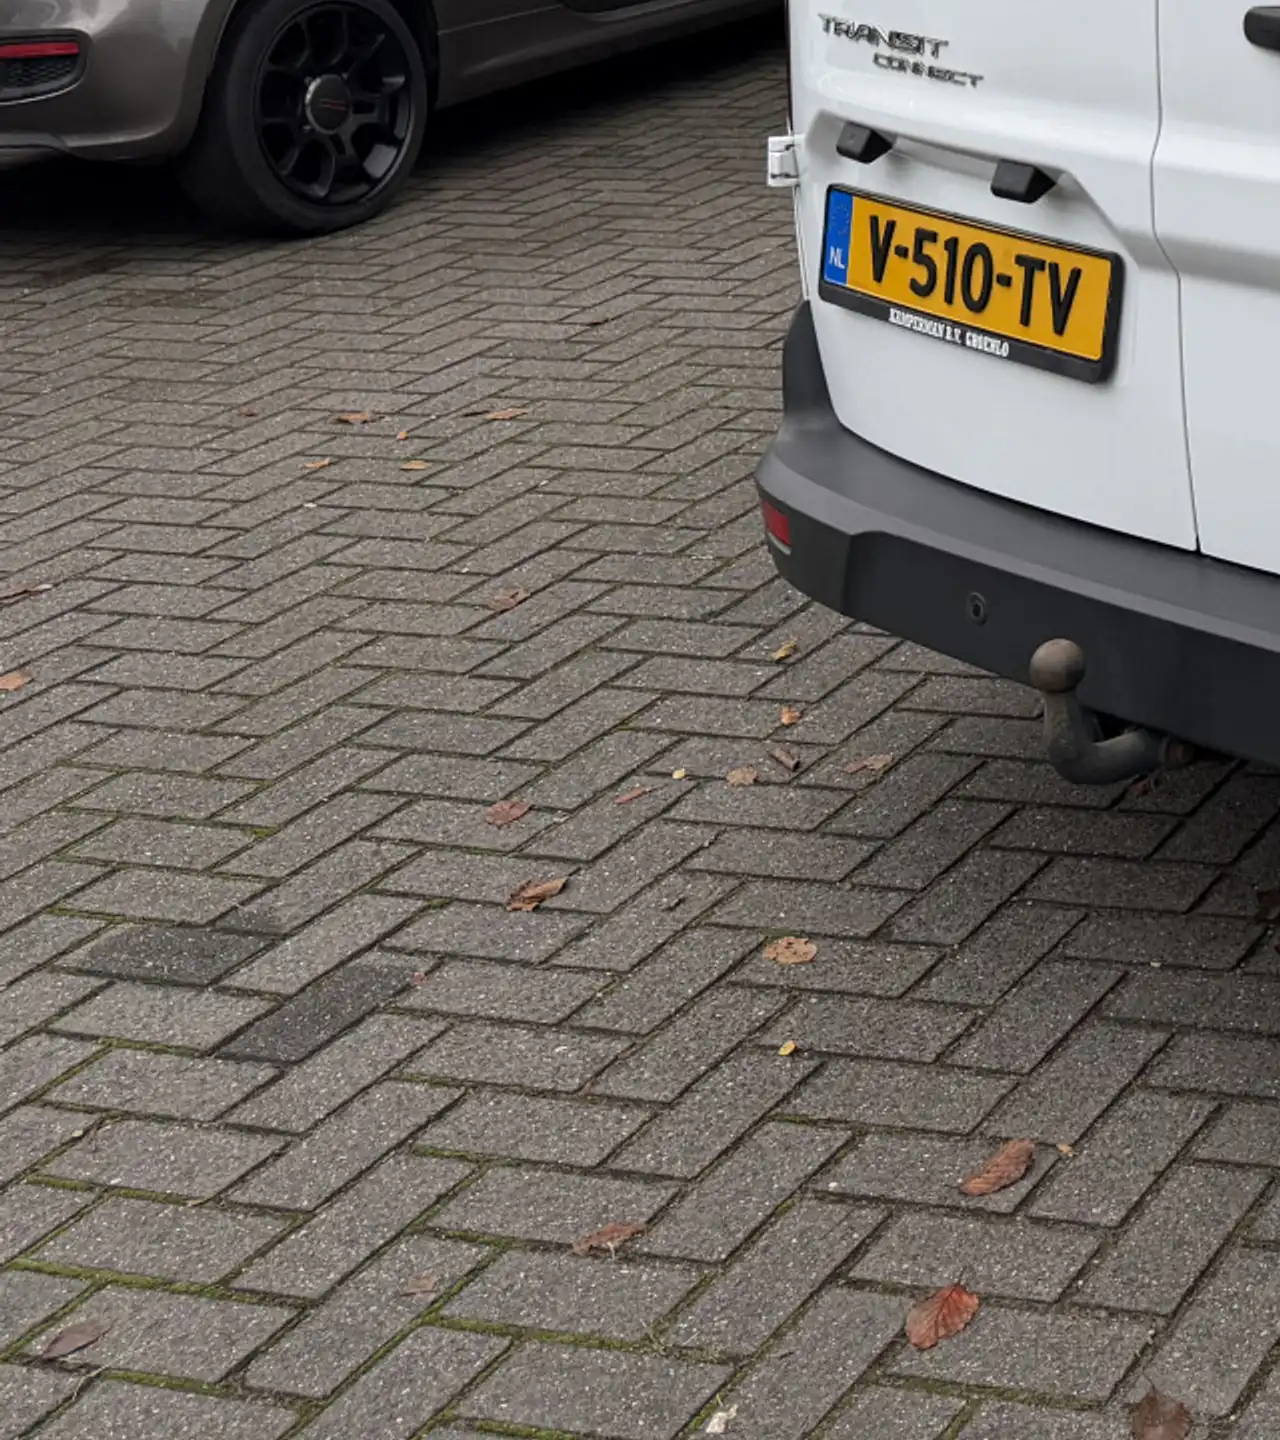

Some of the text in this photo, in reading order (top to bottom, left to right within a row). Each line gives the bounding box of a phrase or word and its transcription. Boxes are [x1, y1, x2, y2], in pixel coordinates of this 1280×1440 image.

[818, 13, 949, 59] TRANSIT
[873, 52, 985, 88] CONNECT
[828, 245, 846, 270] NL
[869, 215, 1082, 337] V-510-TV
